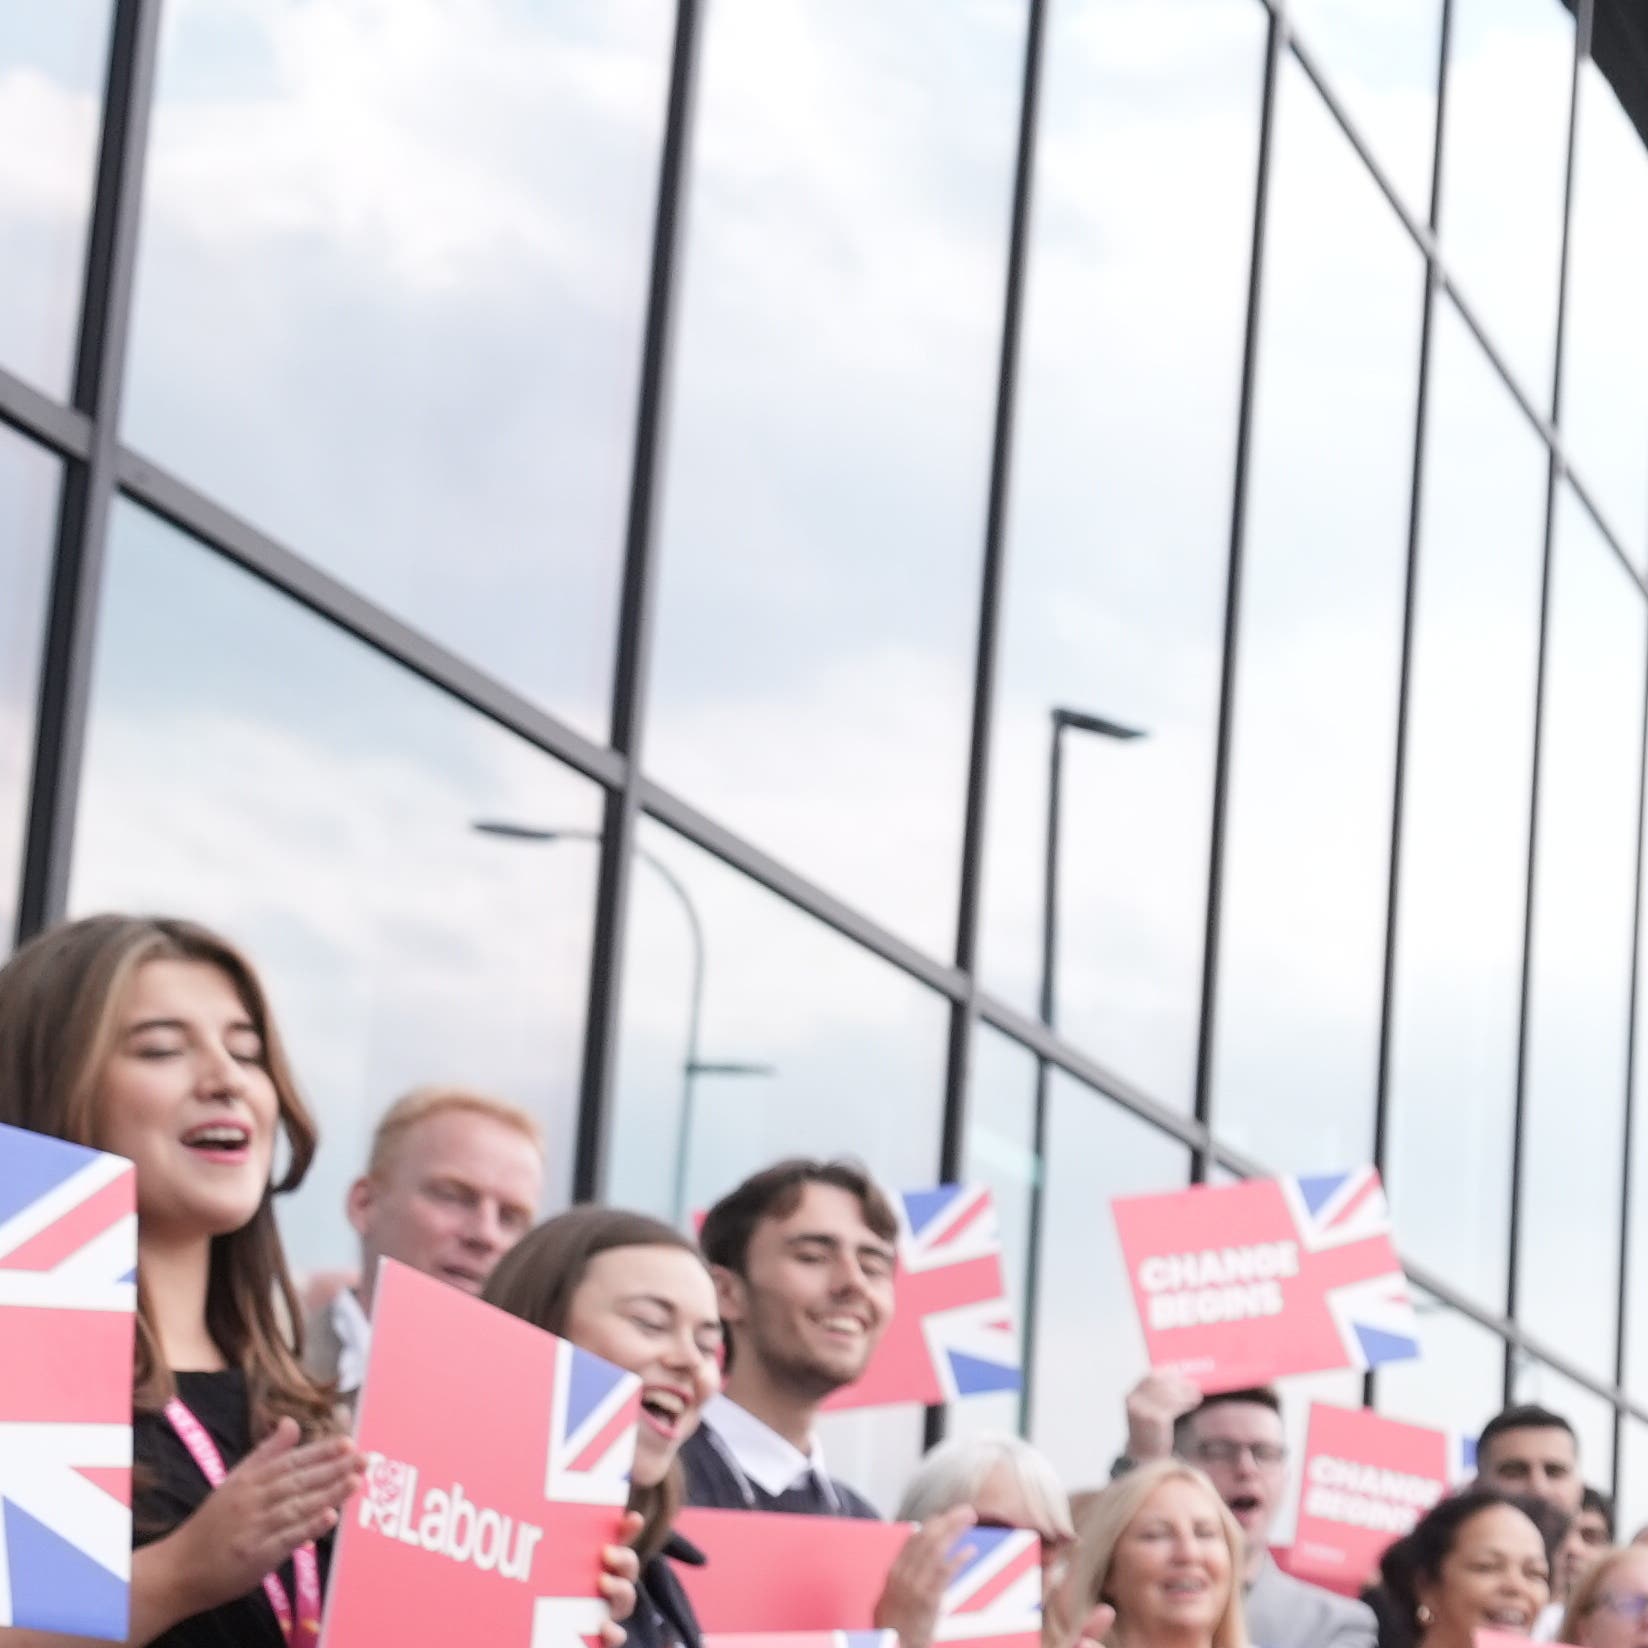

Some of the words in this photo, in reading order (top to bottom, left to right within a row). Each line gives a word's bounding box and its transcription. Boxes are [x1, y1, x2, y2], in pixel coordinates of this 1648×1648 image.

[1138, 1239, 1300, 1294] CHANGE
[1149, 1280, 1285, 1331] BEGINS
[399, 1464, 544, 1583] Labour
